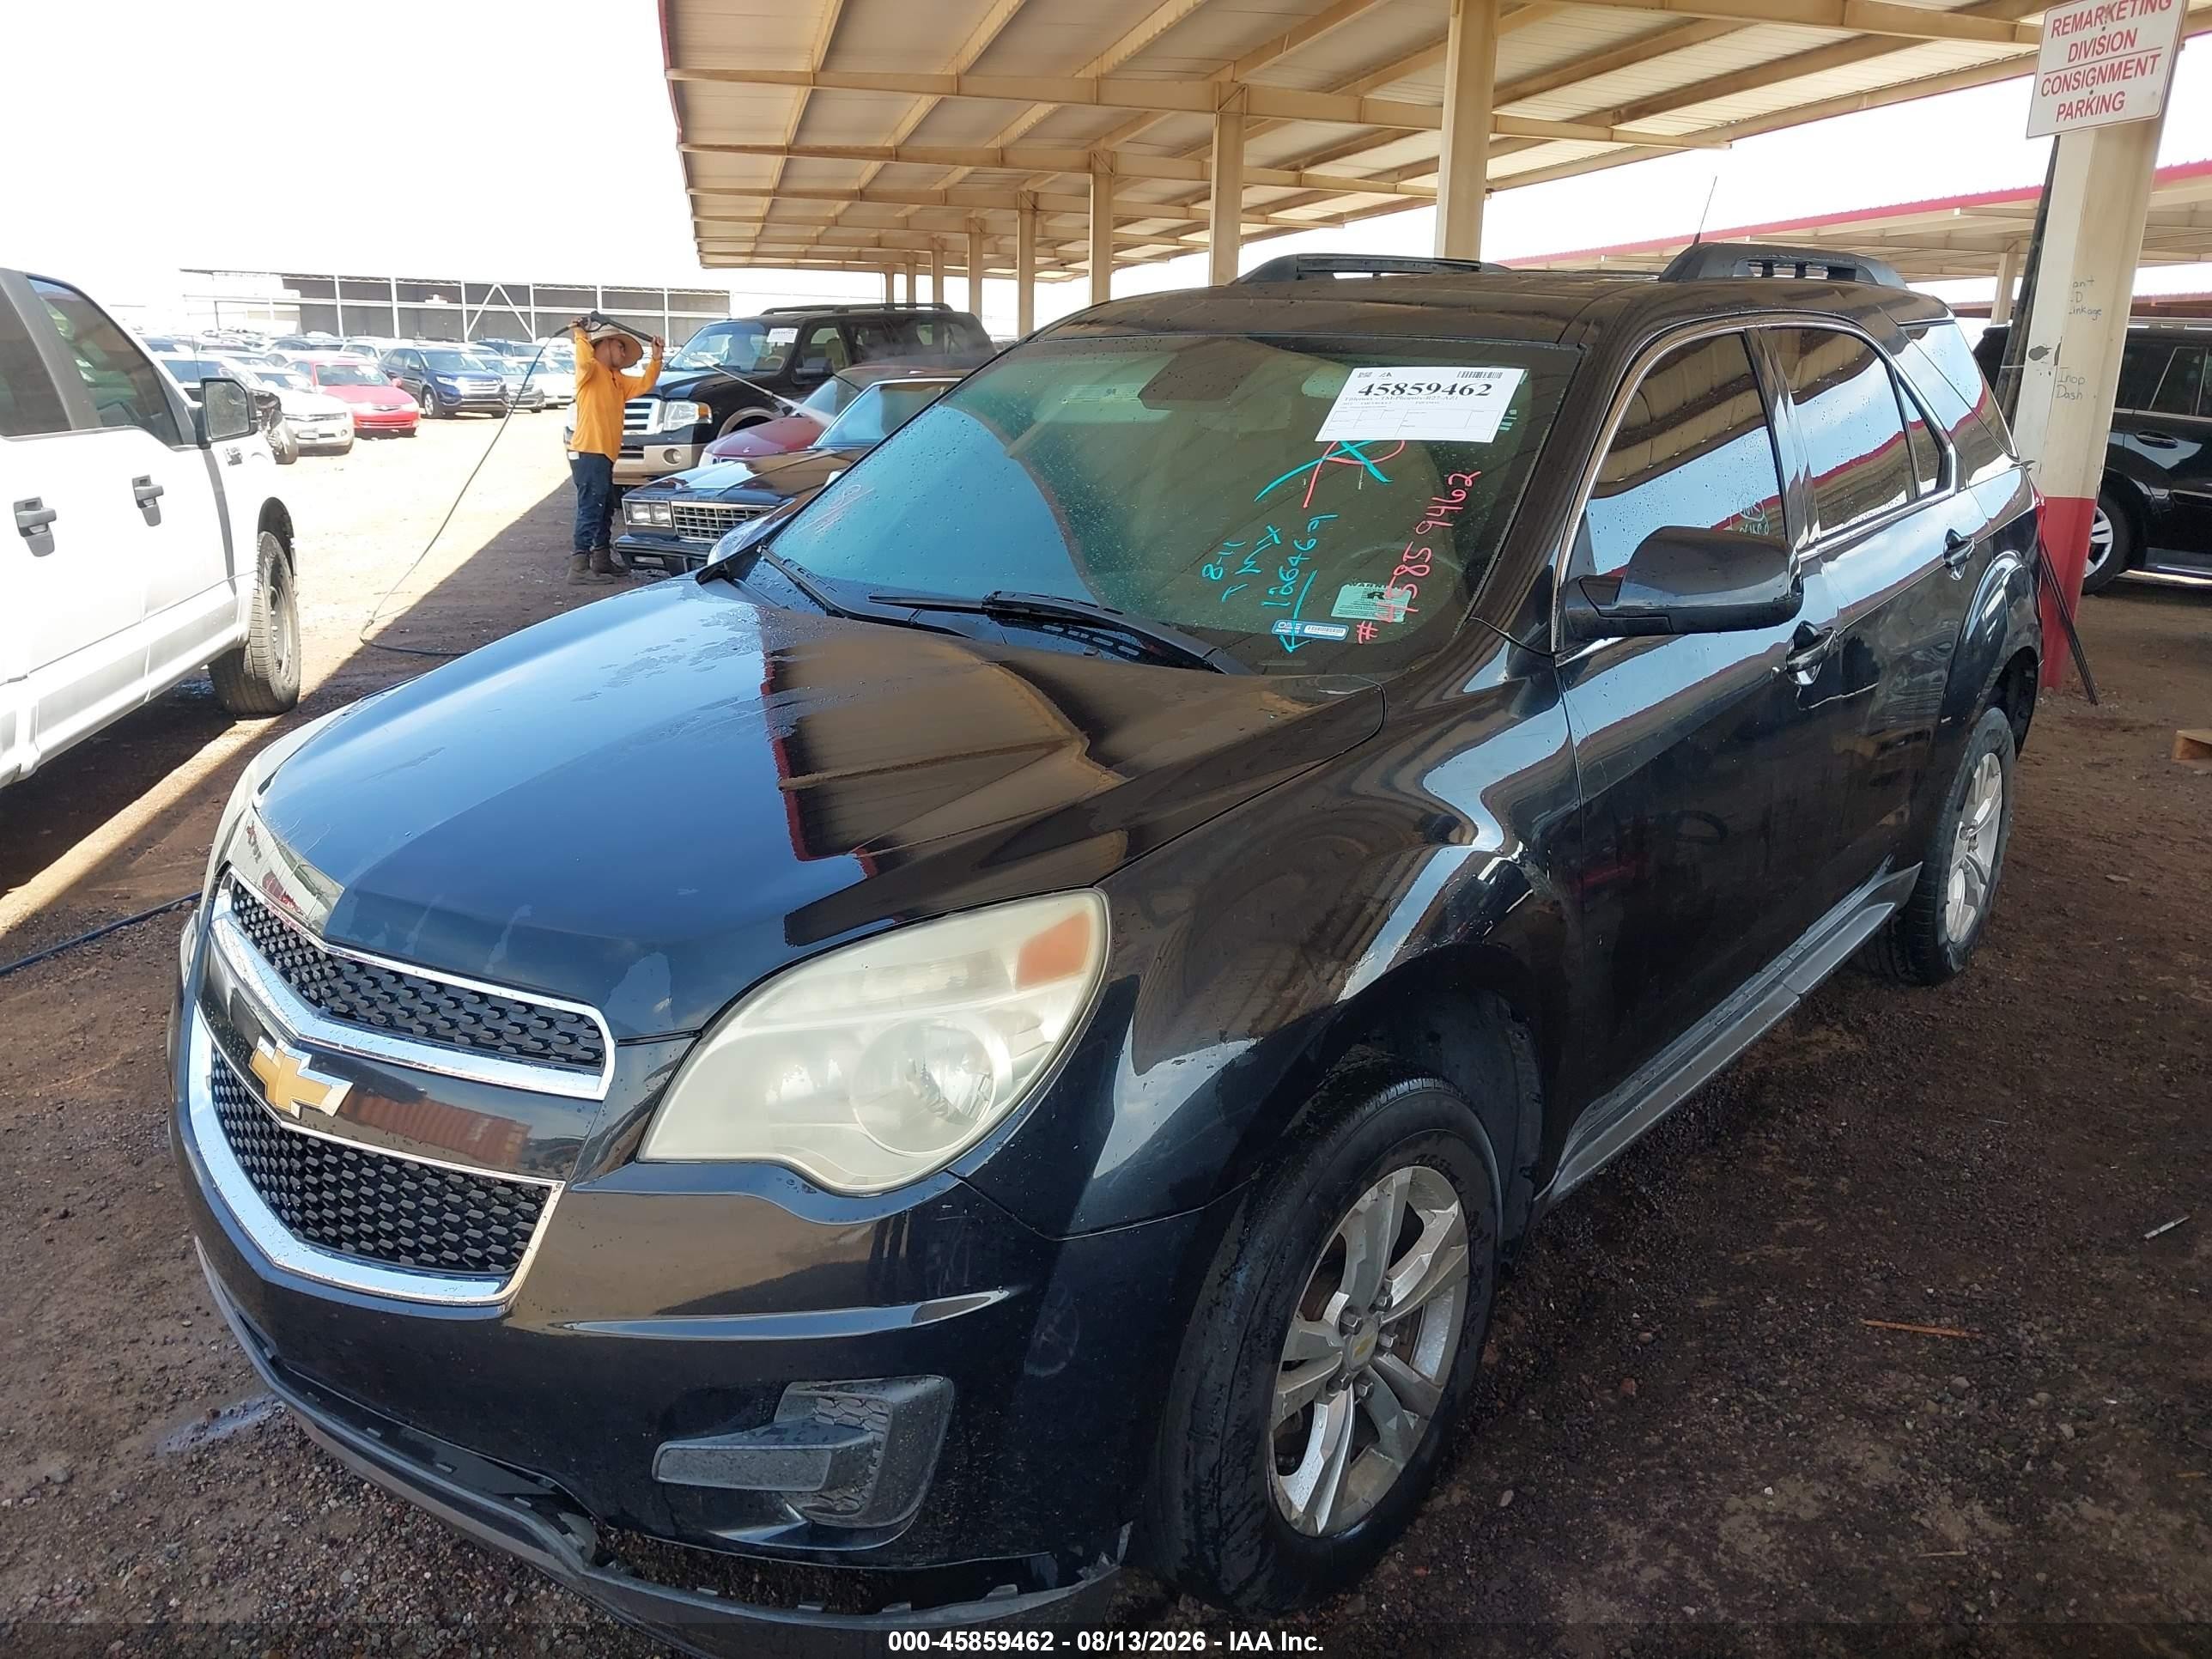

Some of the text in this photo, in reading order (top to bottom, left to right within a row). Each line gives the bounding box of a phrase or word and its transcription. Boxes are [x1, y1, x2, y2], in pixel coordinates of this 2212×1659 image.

[2051, 0, 2172, 39] REMARKETING
[2068, 27, 2137, 64] DIVISION
[2041, 53, 2161, 97] CONSIGNMENT
[2056, 90, 2125, 123] PARKING
[1358, 382, 1492, 397] 45859462
[2056, 384, 2083, 400] Dash
